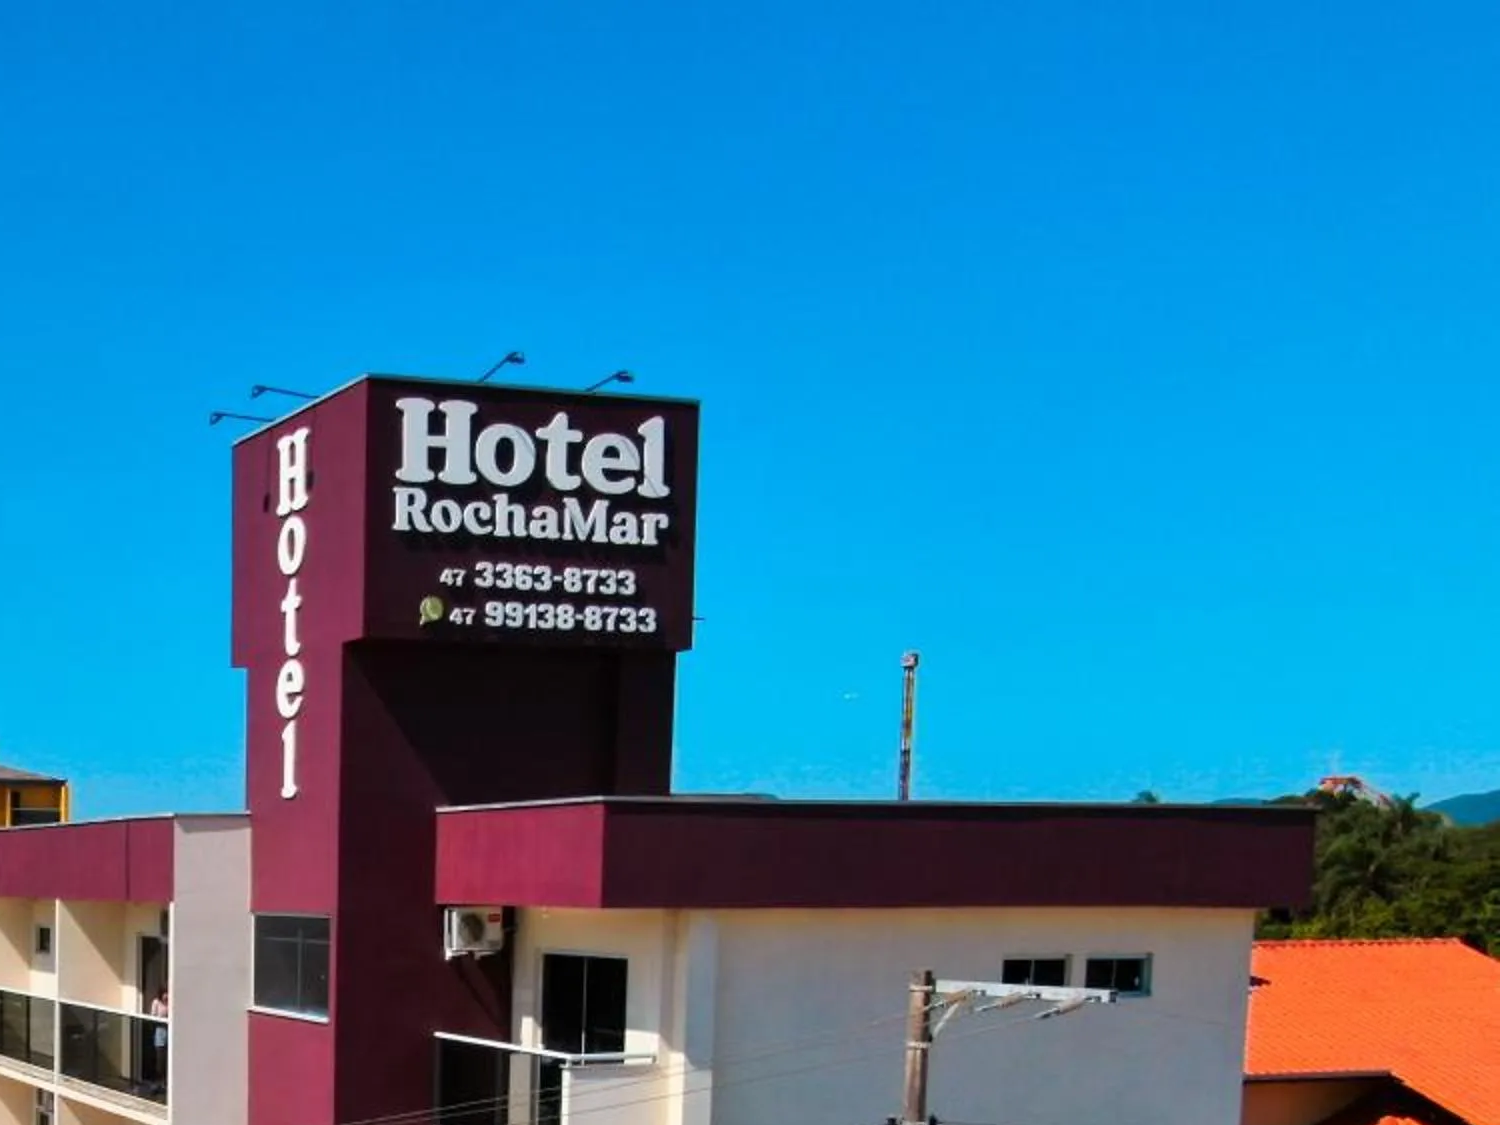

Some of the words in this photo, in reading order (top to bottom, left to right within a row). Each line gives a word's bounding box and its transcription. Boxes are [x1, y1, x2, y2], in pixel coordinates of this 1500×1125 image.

[395, 397, 670, 498] Hotel
[391, 485, 669, 545] RochaMar
[439, 568, 465, 586] 47
[474, 561, 637, 595] 3363-8733
[275, 427, 311, 799] Hotel
[448, 606, 476, 626] 47
[484, 600, 657, 633] 99138-8733
